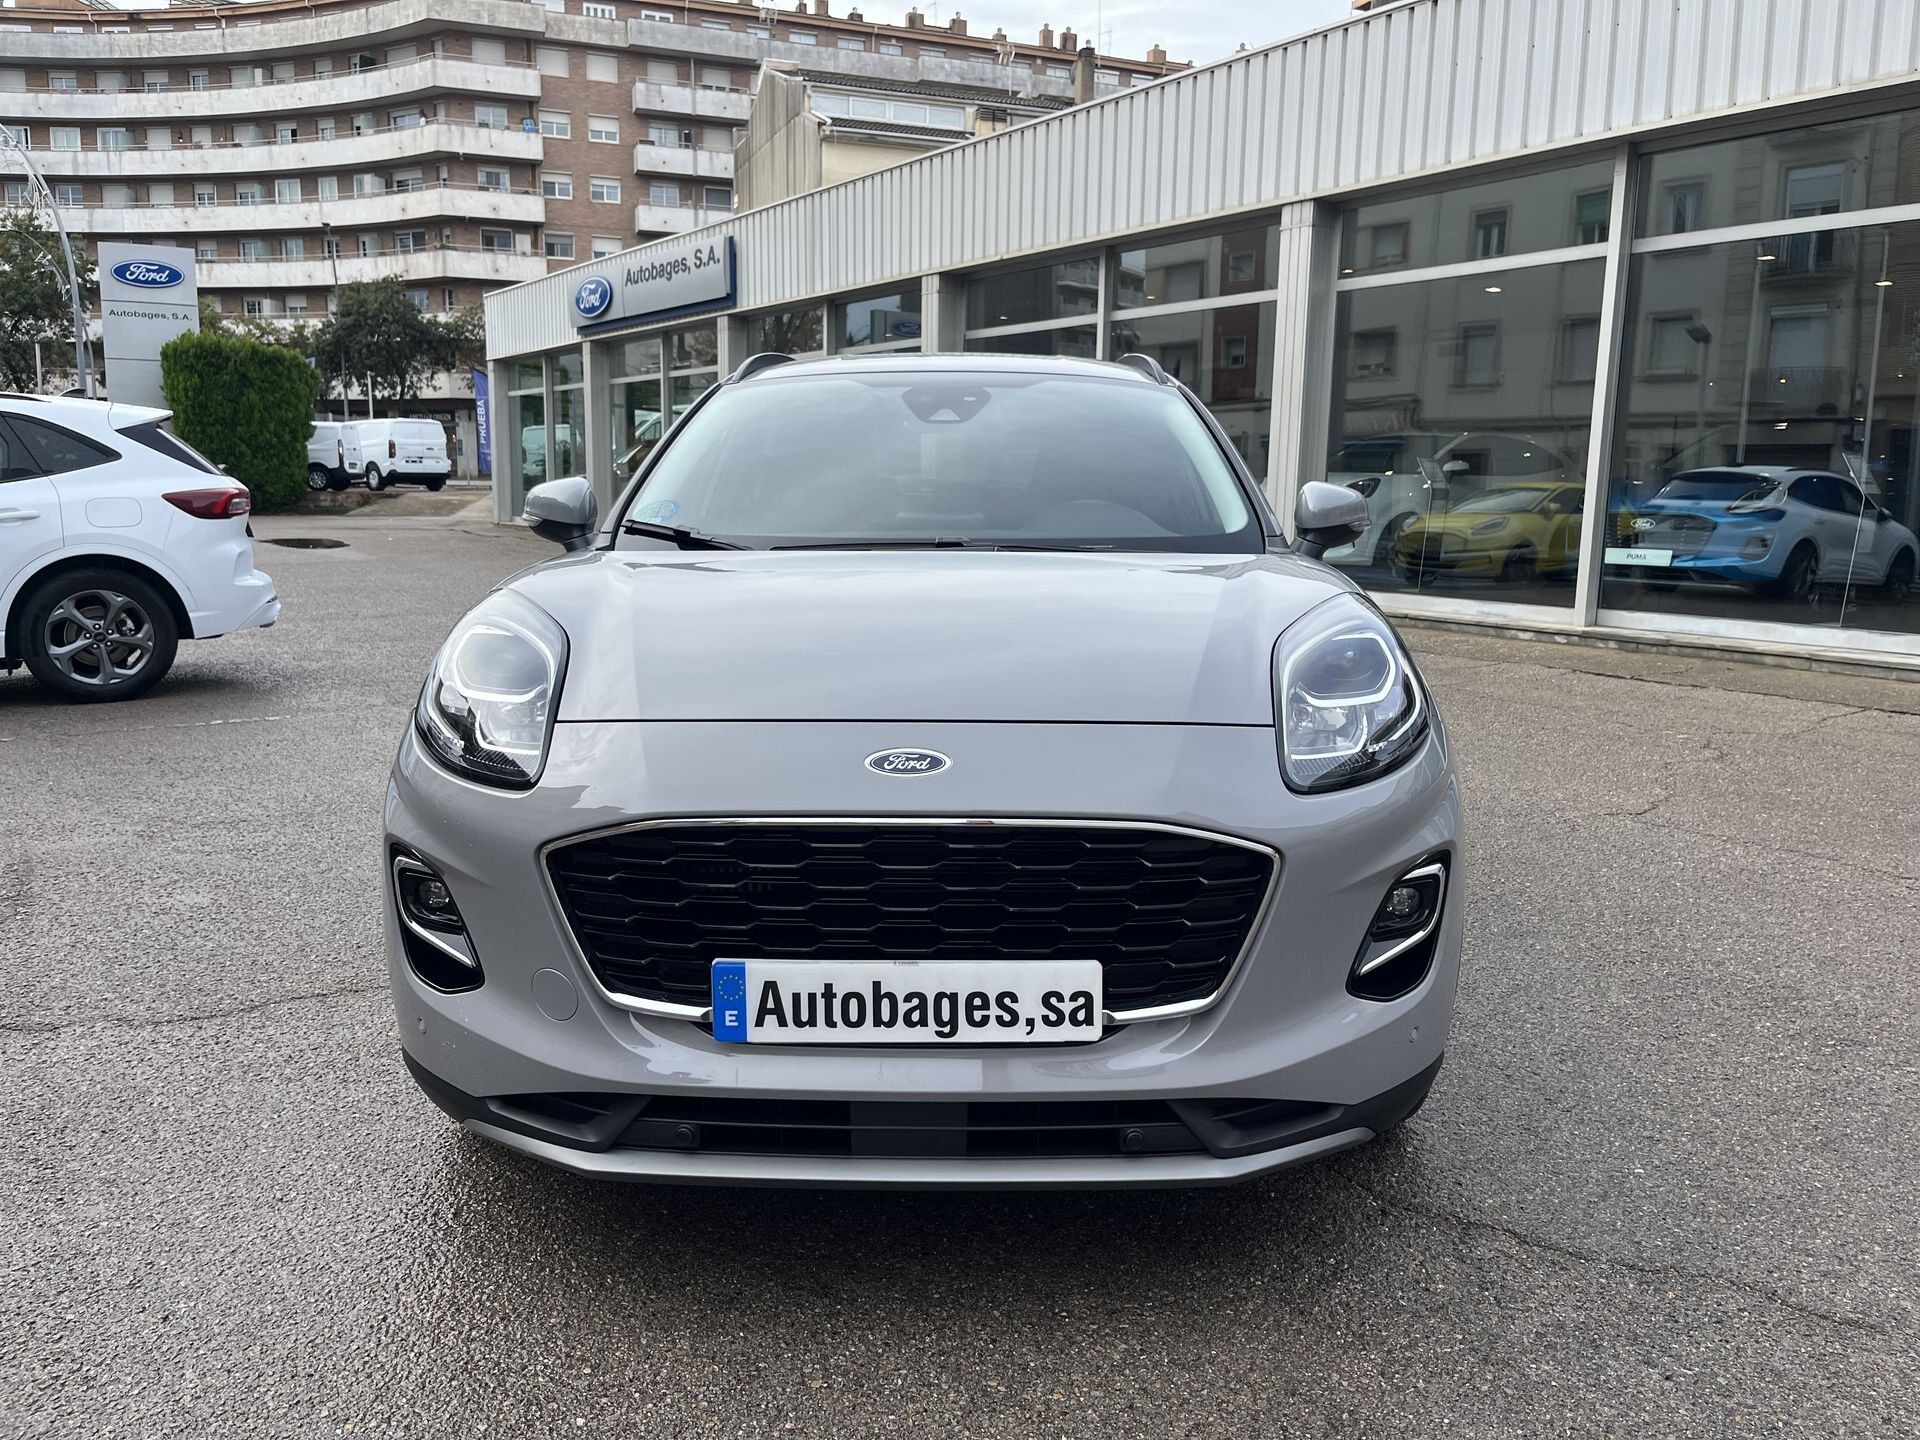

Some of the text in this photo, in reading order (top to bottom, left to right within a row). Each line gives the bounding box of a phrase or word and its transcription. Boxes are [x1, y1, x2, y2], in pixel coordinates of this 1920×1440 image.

[126, 263, 169, 282] Ford
[625, 246, 720, 287] Autobages, S.A.
[579, 284, 602, 310] Ford
[109, 309, 192, 321] Autobages, S.A.
[476, 399, 487, 444] PRUEBA
[1626, 553, 1647, 561] PUMA
[883, 753, 931, 770] Ford
[724, 980, 1095, 1039] E Autobages,sa
